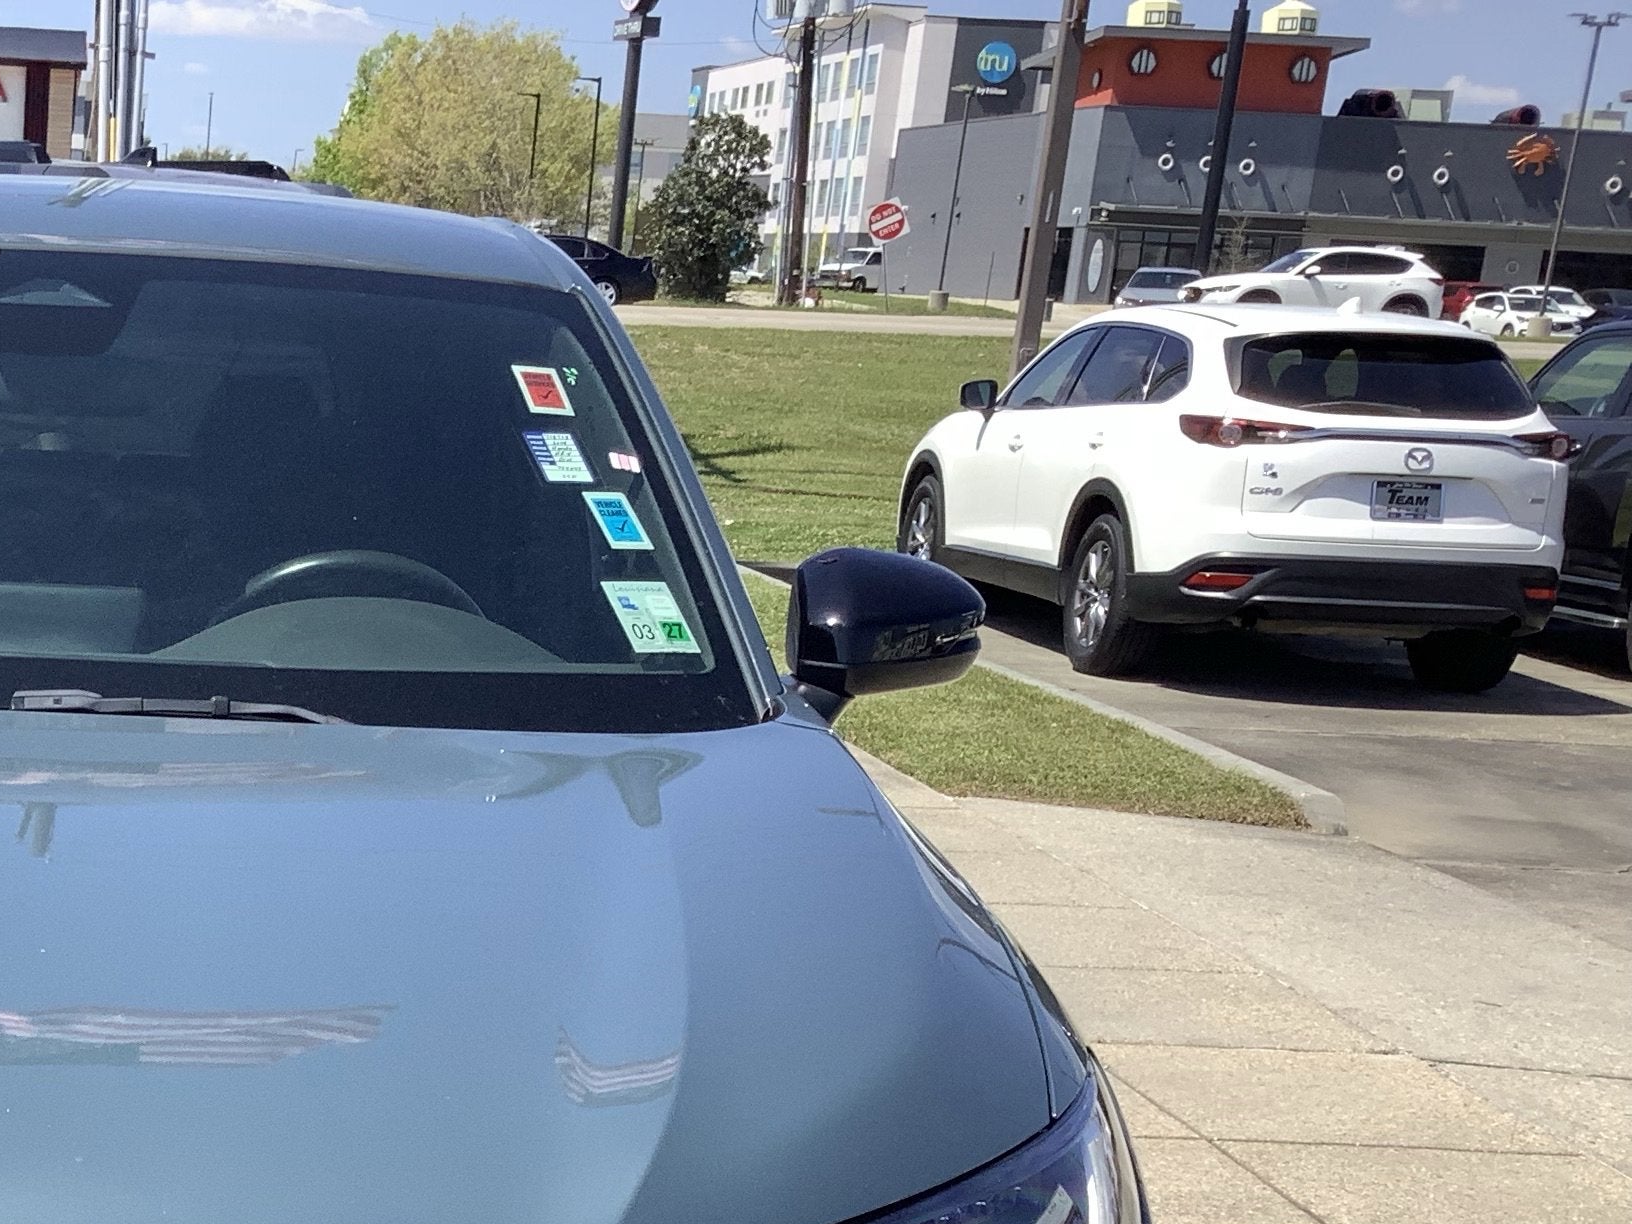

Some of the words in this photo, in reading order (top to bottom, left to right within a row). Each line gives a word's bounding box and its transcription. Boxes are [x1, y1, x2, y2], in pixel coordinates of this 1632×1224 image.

[979, 48, 1009, 71] tru
[870, 212, 882, 223] DO
[881, 206, 897, 217] NOT
[878, 222, 900, 237] ENTER
[1388, 489, 1430, 506] TEAM
[631, 623, 656, 640] 03
[662, 622, 684, 639] 27
